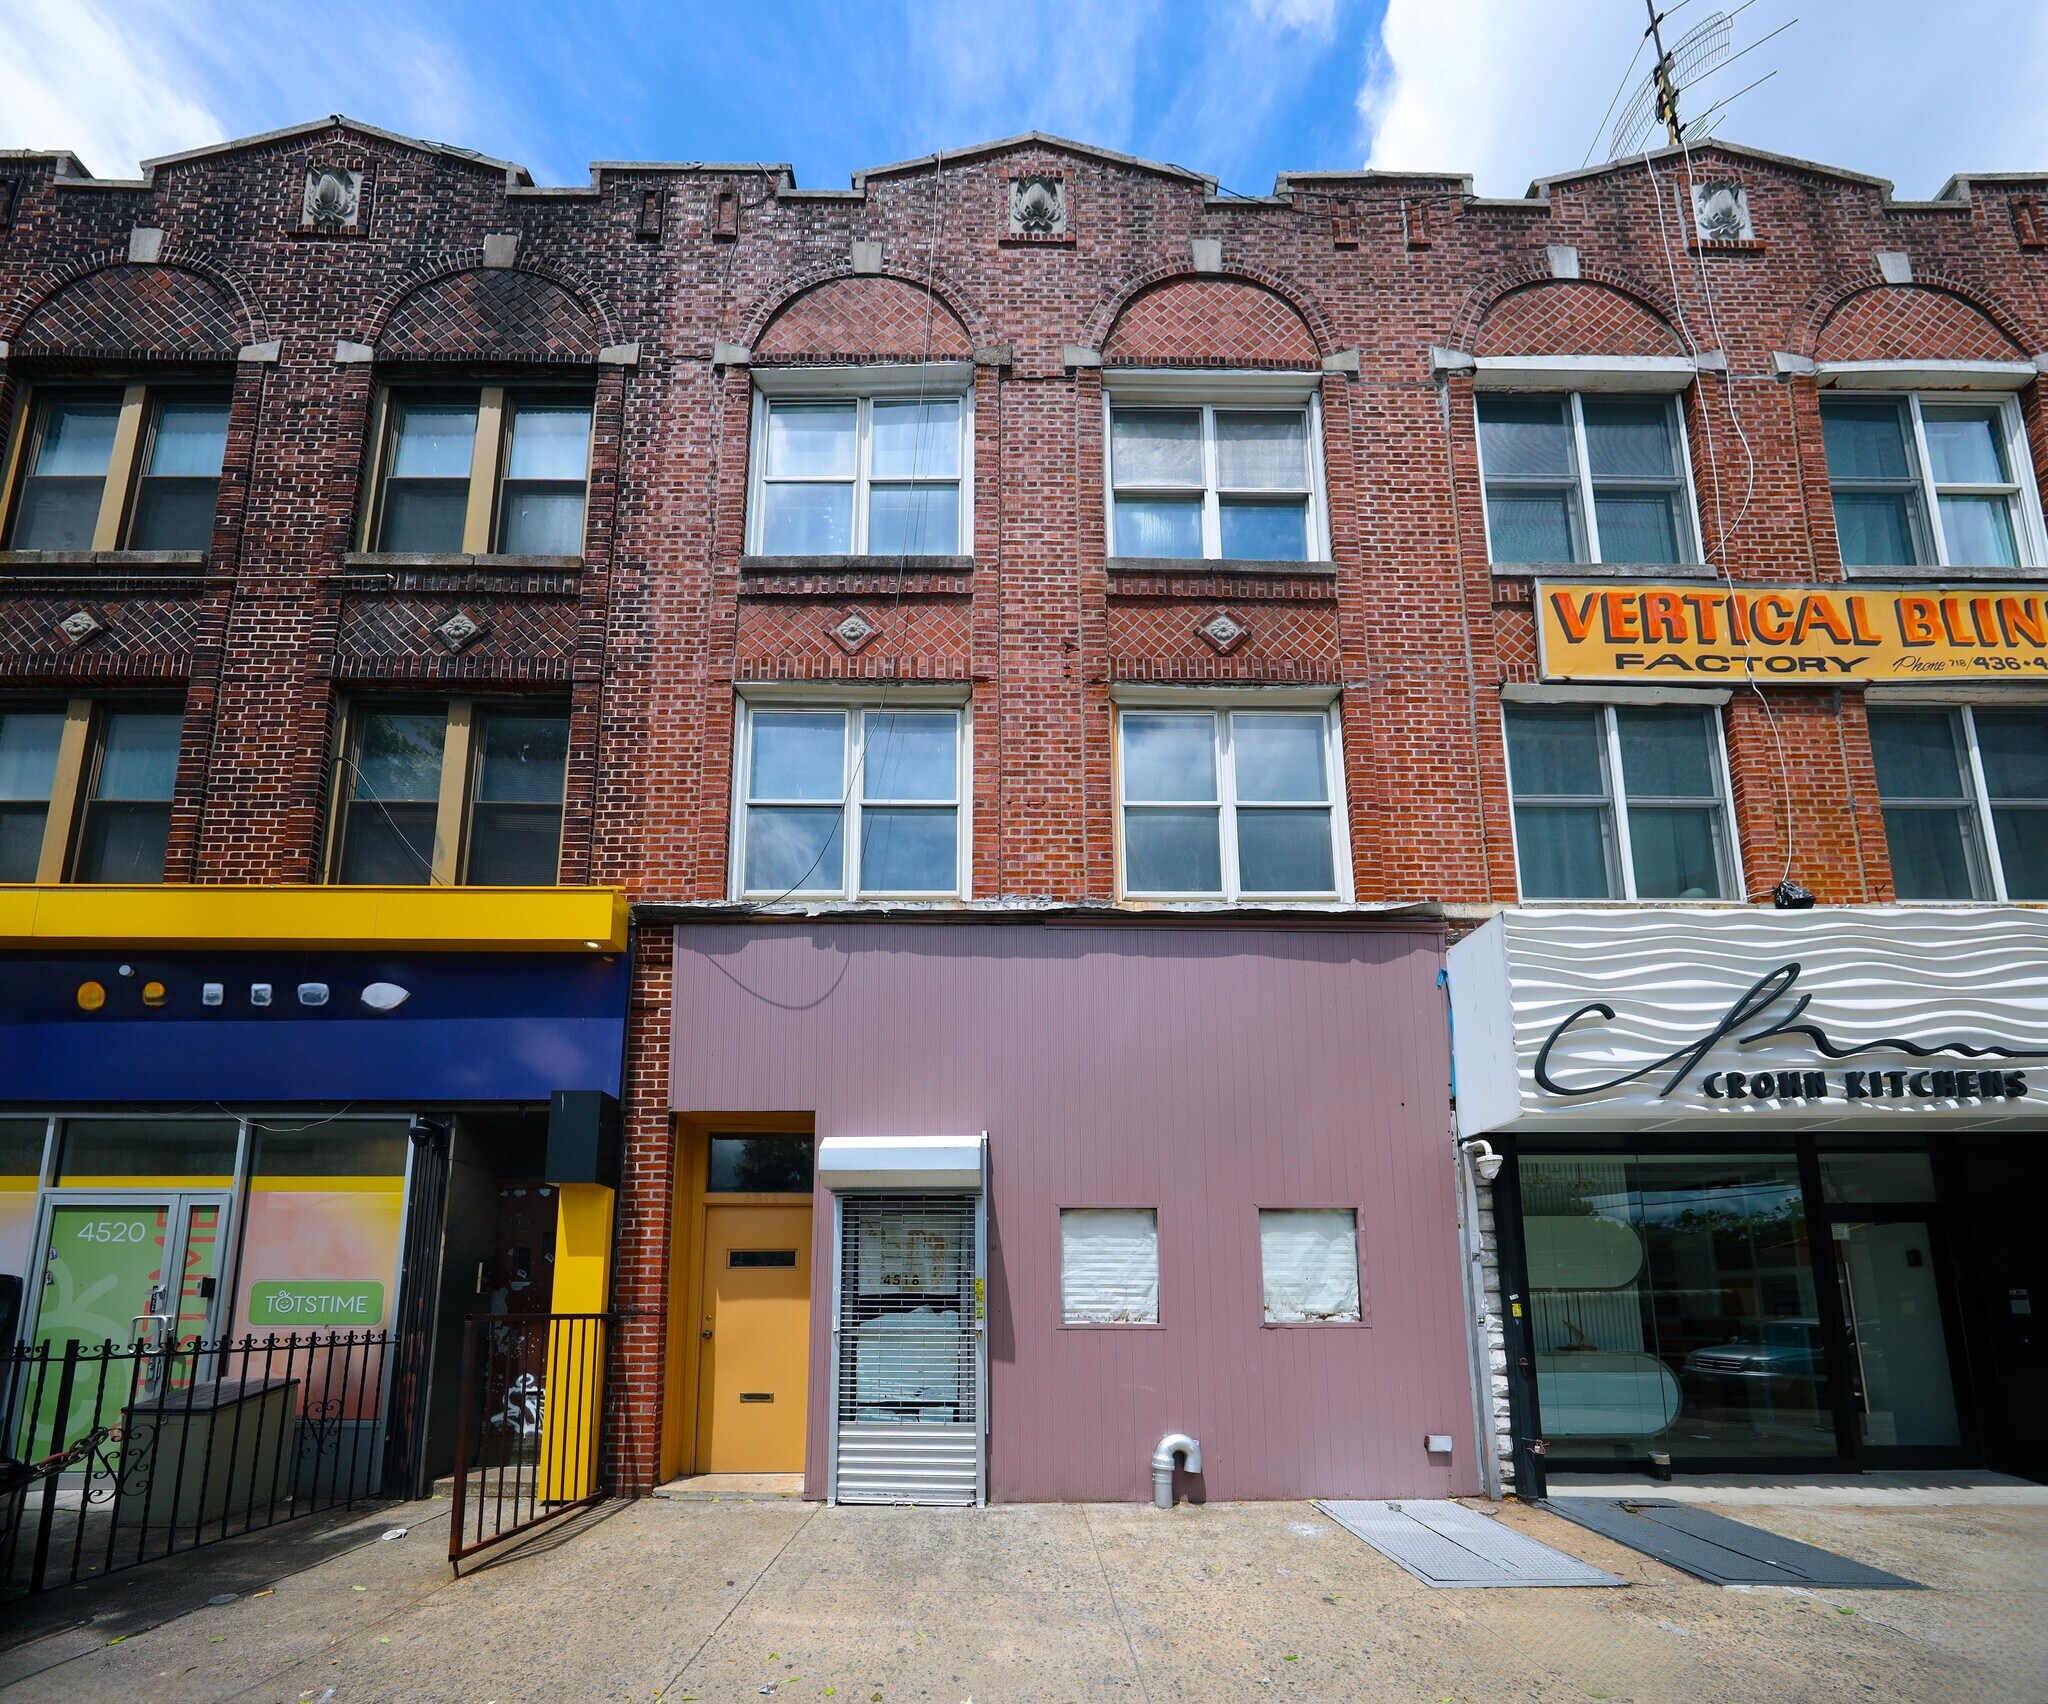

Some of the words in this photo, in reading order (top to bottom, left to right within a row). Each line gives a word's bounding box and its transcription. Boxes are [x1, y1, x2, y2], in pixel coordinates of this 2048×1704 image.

[1550, 592, 1883, 646] VERTICAL
[1893, 597, 2048, 648] BLIN
[1615, 653, 1871, 673] FACTORY
[1892, 655, 1946, 673] Phone
[1703, 1071, 1829, 1100] CROWN
[1845, 1070, 2028, 1099] KITCHENS
[77, 1222, 146, 1242] 4520
[265, 1290, 368, 1314] TOTSTIME
